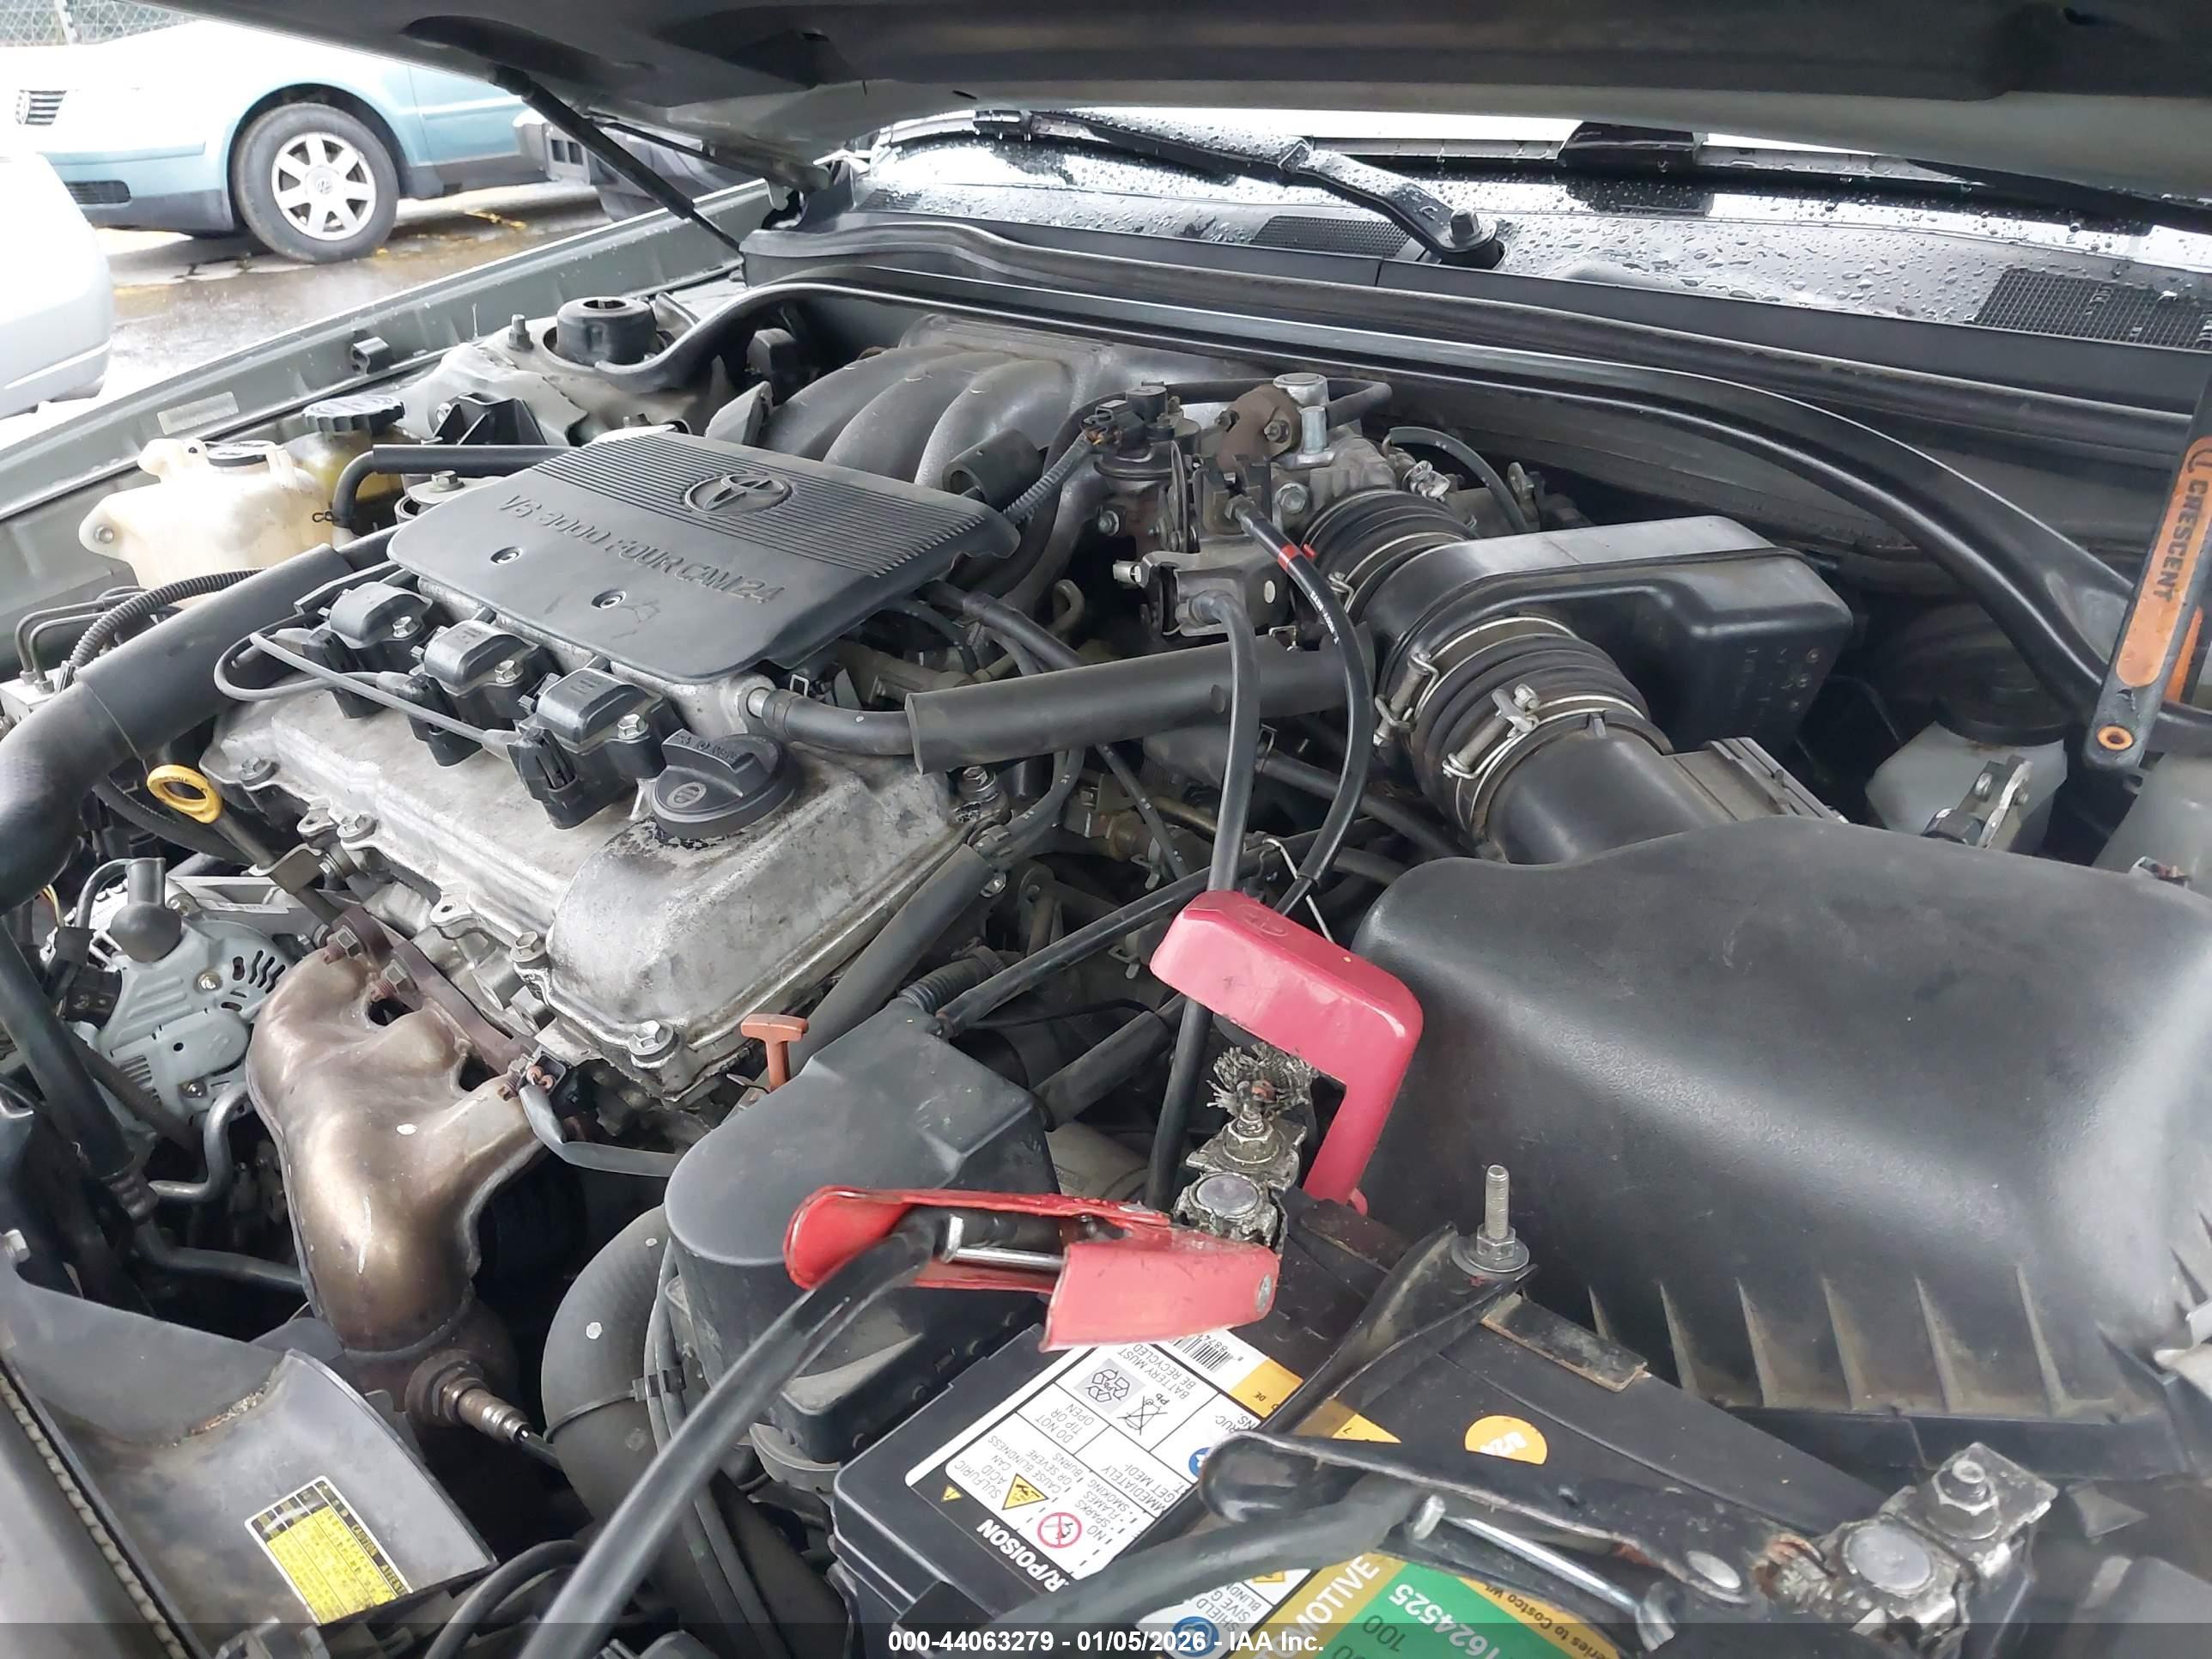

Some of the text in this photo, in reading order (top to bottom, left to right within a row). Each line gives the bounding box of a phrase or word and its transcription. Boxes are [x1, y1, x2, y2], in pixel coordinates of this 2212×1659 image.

[498, 495, 785, 604] V6 3000 FOUR CAM 24
[2153, 478, 2209, 603] CRESCENT
[1116, 1347, 1190, 1400] BATTERY MUST
[1133, 1343, 1196, 1390] BE RECYCLED
[1066, 1403, 1095, 1426] OPEN
[1155, 1393, 1170, 1406] Pb
[1035, 1414, 1073, 1443] DO NOT
[1050, 1408, 1083, 1435] TIP OR
[954, 1459, 1002, 1499] SULFURIC
[981, 1463, 1007, 1485] ACID
[988, 1435, 1063, 1495] CAUSE BLINDNESS
[991, 1455, 1012, 1472] CAN
[1026, 1449, 1073, 1486] OR SEVERE
[1052, 1451, 1084, 1478] BURNS
[1083, 1491, 1121, 1520] FLAMES
[1087, 1479, 1131, 1512] SMOKING
[1150, 1484, 1176, 1504] GET
[1074, 1499, 1111, 1528] SPARKS
[351, 1523, 379, 1558] CAUTION
[1086, 1525, 1107, 1542] NO
[976, 1518, 1070, 1593] R/POISON
[1196, 1597, 1241, 1632] SHIELD
[1219, 1597, 1251, 1623] SIVE
[1255, 1555, 1381, 1659] OMOTIVE
[1507, 1594, 1553, 1630] Costco
[1362, 1614, 1408, 1653] 100
[1554, 1626, 1570, 1641] to
